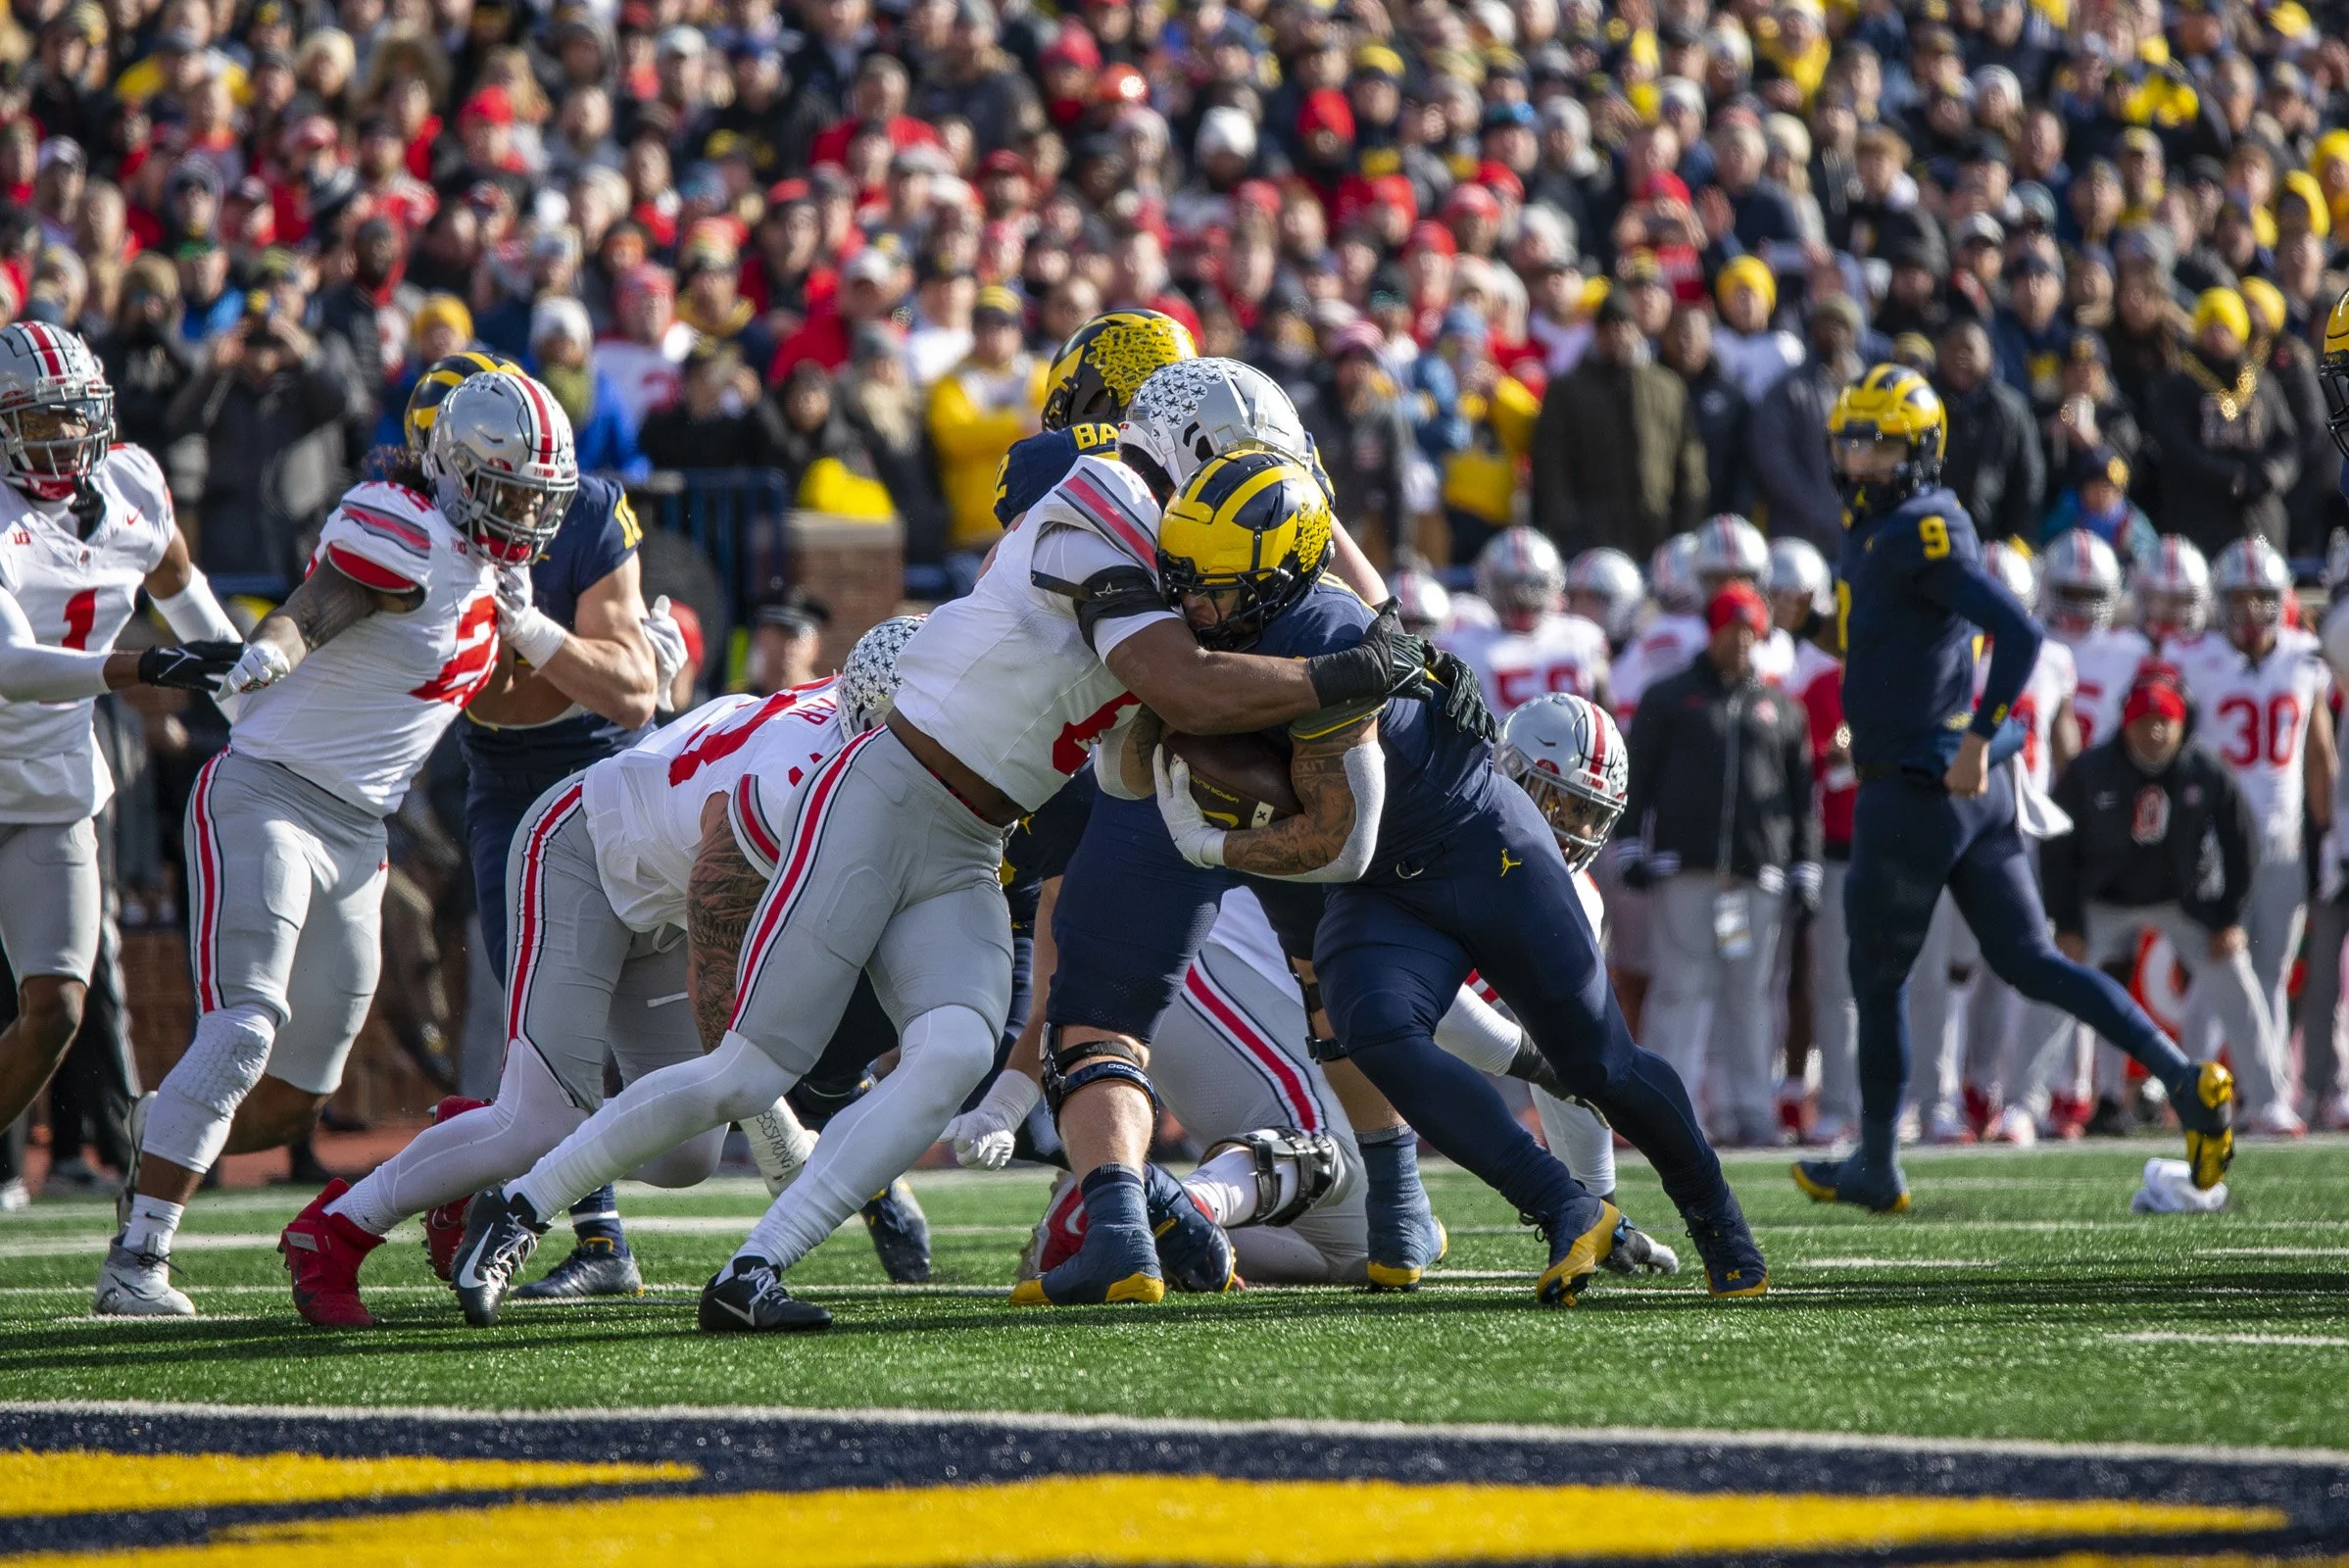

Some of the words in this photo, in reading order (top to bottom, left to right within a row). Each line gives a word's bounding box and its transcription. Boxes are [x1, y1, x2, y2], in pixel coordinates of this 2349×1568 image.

[1072, 422, 1126, 451] BA
[1918, 515, 1950, 561] 9
[62, 588, 97, 652] 1
[2217, 692, 2299, 769] 30
